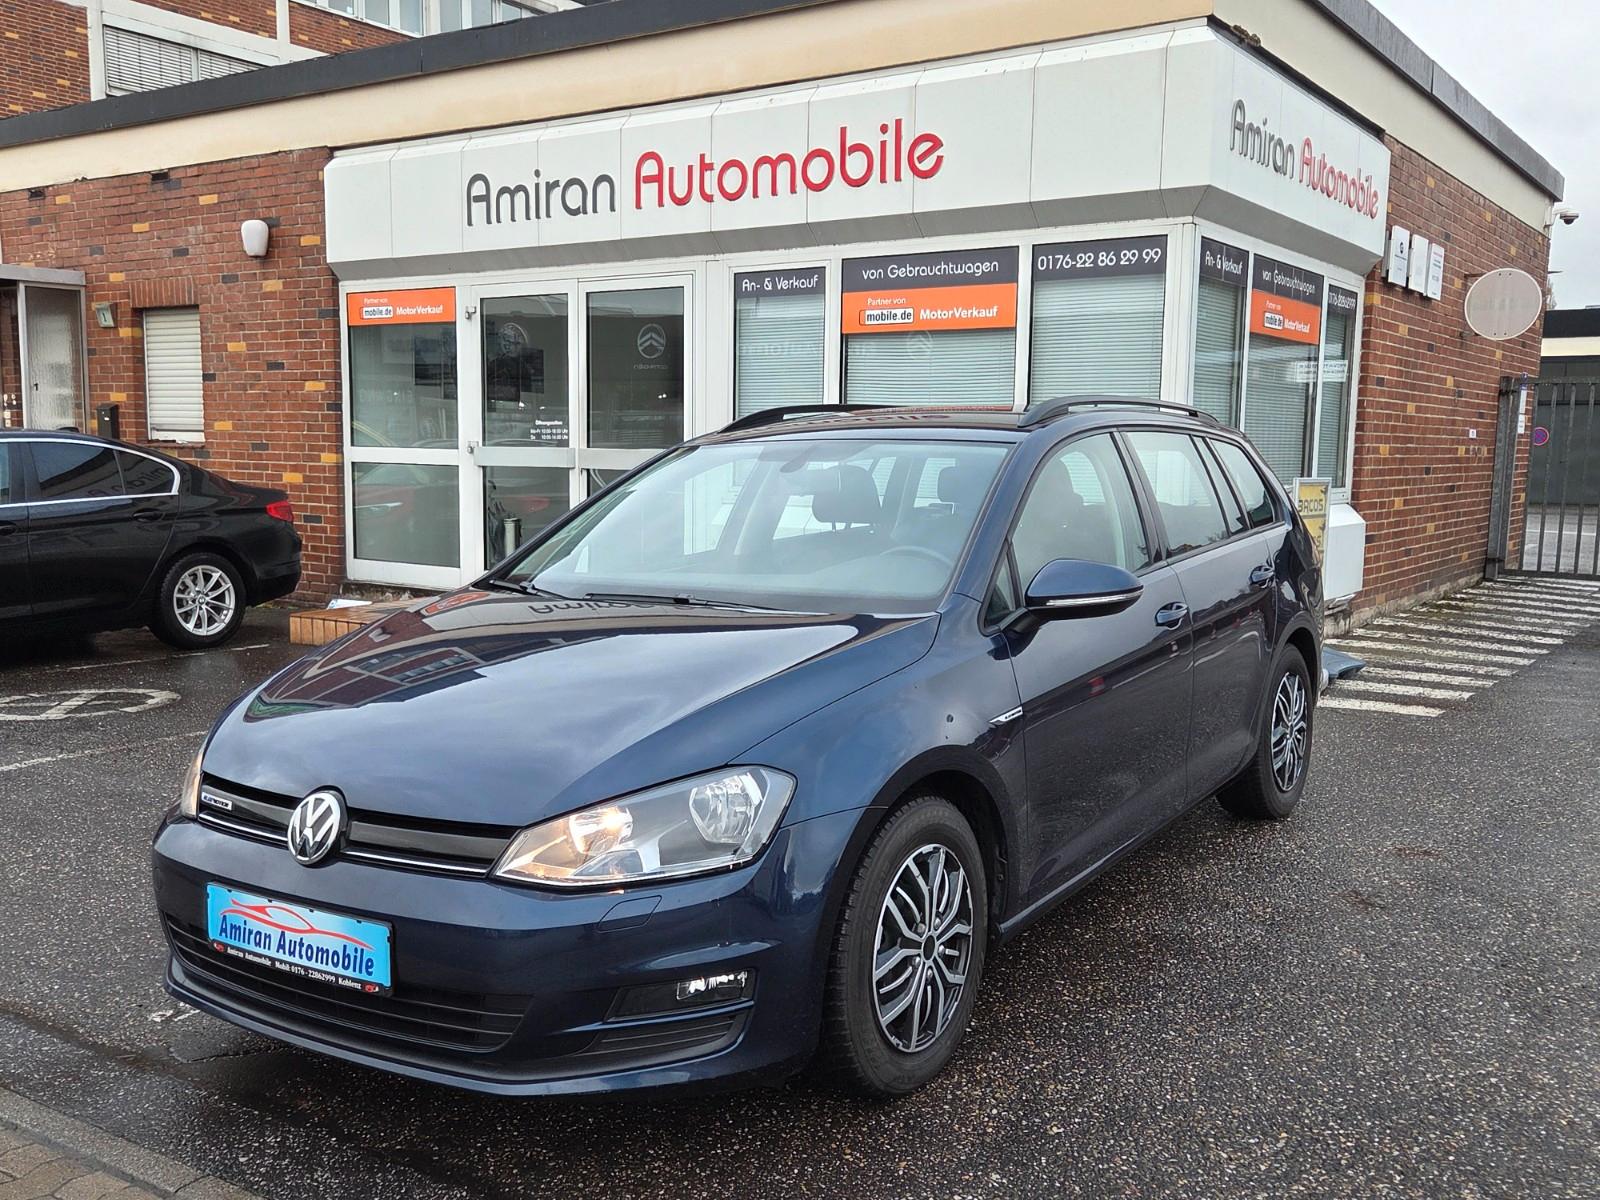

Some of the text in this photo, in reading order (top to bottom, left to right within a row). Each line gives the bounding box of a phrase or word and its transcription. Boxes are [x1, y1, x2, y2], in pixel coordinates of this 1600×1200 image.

[1230, 99, 1379, 219] Amiran Automobile
[466, 118, 944, 227] Amiran Automobile
[1037, 248, 1162, 271] 0176-22 86 29 99
[861, 260, 999, 280] von Gebrauchtwagen
[742, 274, 819, 292] An- & Verkauf
[867, 296, 907, 306] Partner von
[364, 307, 392, 317] mobile.de
[866, 306, 999, 323] mobile.de MotorVerkauf
[219, 915, 375, 977] Amiran Automobile
[338, 976, 362, 990] Koblenz
